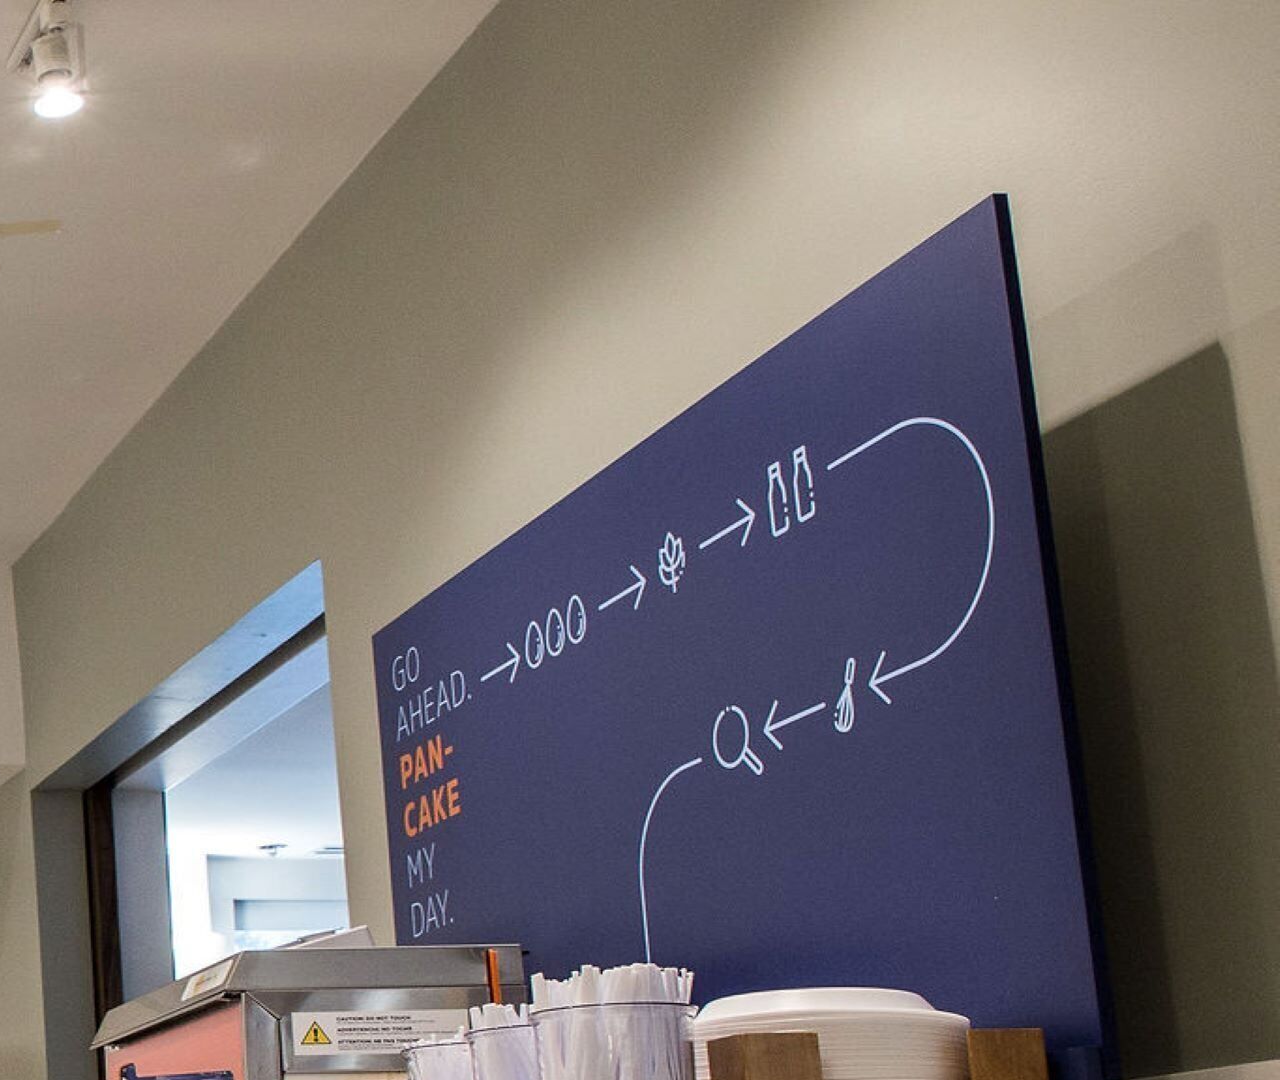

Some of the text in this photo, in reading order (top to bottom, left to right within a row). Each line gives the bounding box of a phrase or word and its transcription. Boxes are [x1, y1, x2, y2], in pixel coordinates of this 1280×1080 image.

[392, 646, 420, 692] GO
[396, 669, 472, 741] AHEAD.
[399, 733, 454, 789] PAN-
[403, 777, 462, 838] CAKE
[406, 842, 436, 888] MY
[410, 889, 454, 938] DAY.
